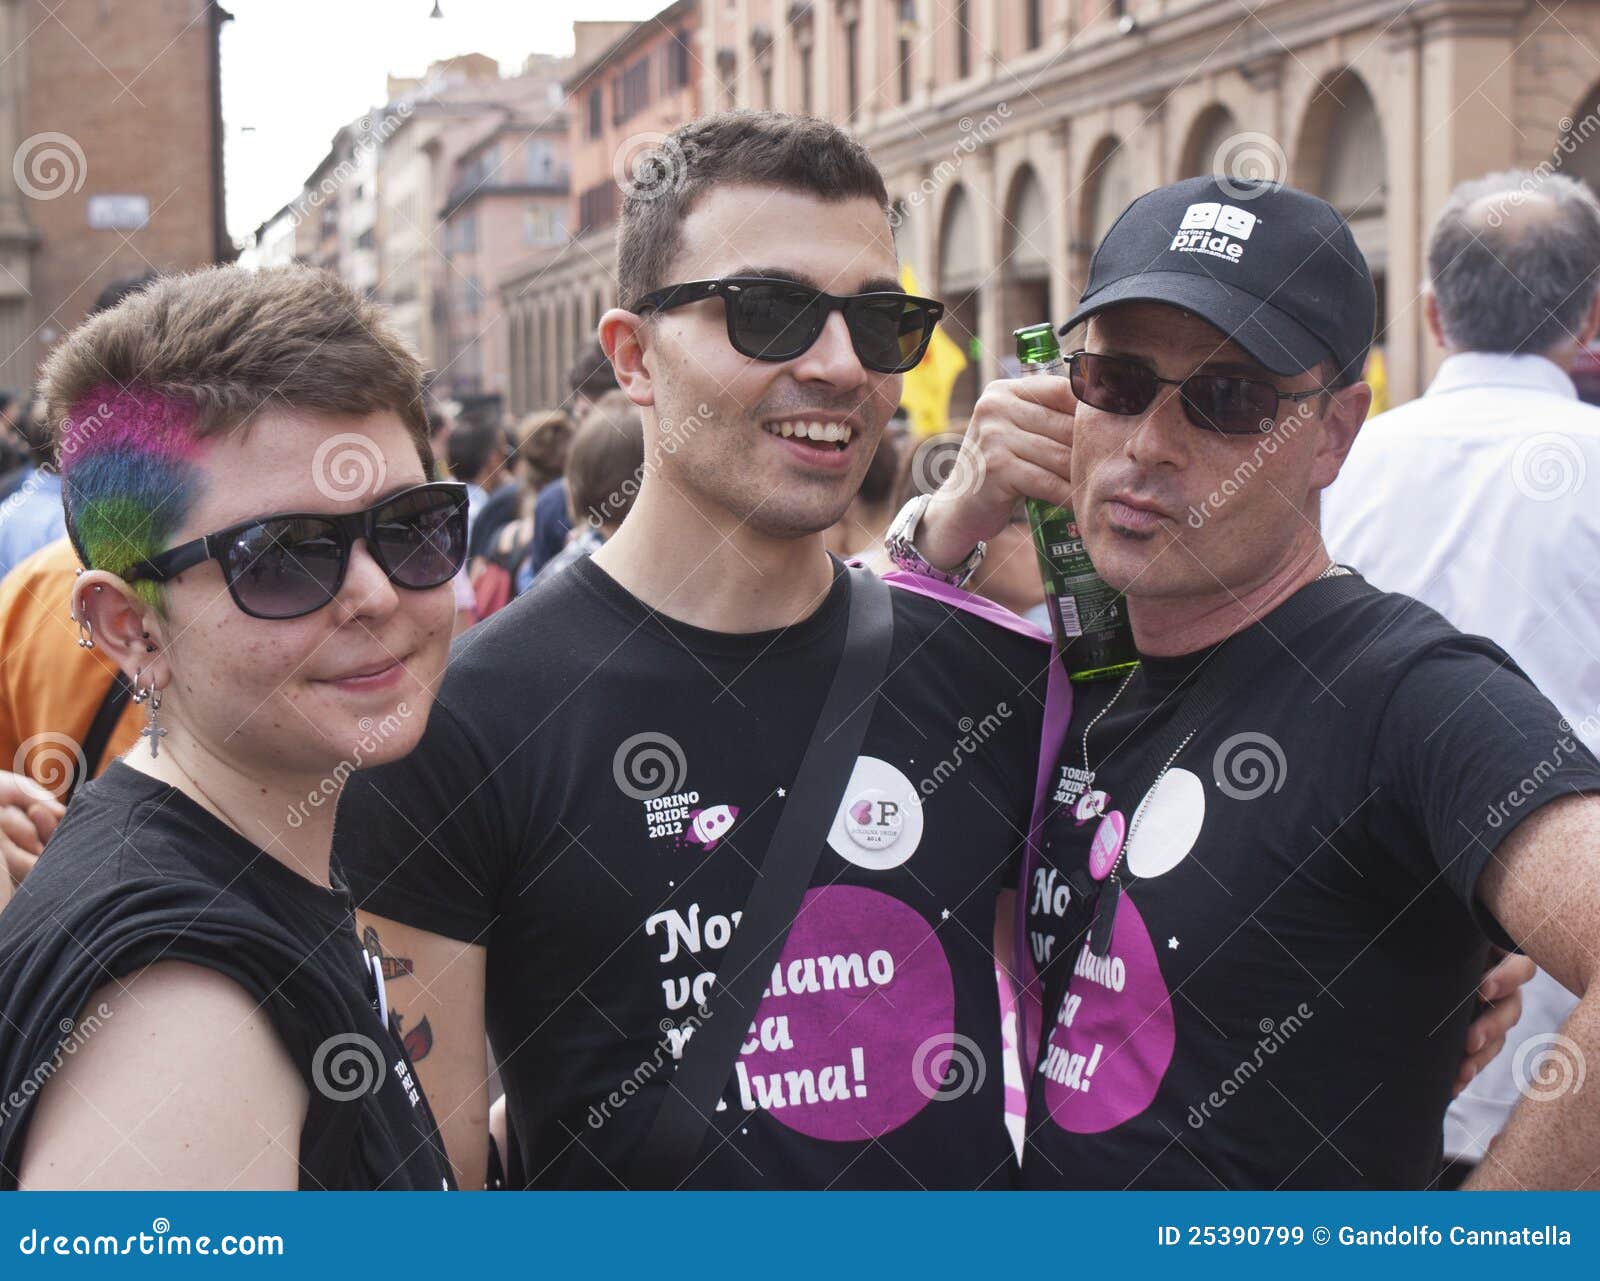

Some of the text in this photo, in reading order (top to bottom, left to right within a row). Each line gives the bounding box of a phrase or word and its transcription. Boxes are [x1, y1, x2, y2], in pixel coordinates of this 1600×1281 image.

[1169, 230, 1244, 258] pride
[1060, 765, 1095, 783] TORINO
[1058, 778, 1087, 795] PRIDE
[643, 791, 700, 812] TORINO
[646, 806, 690, 825] PRIDE
[648, 821, 683, 838] 2012
[1031, 867, 1072, 917] No
[645, 903, 743, 963] No
[735, 1046, 867, 1111] luna!
